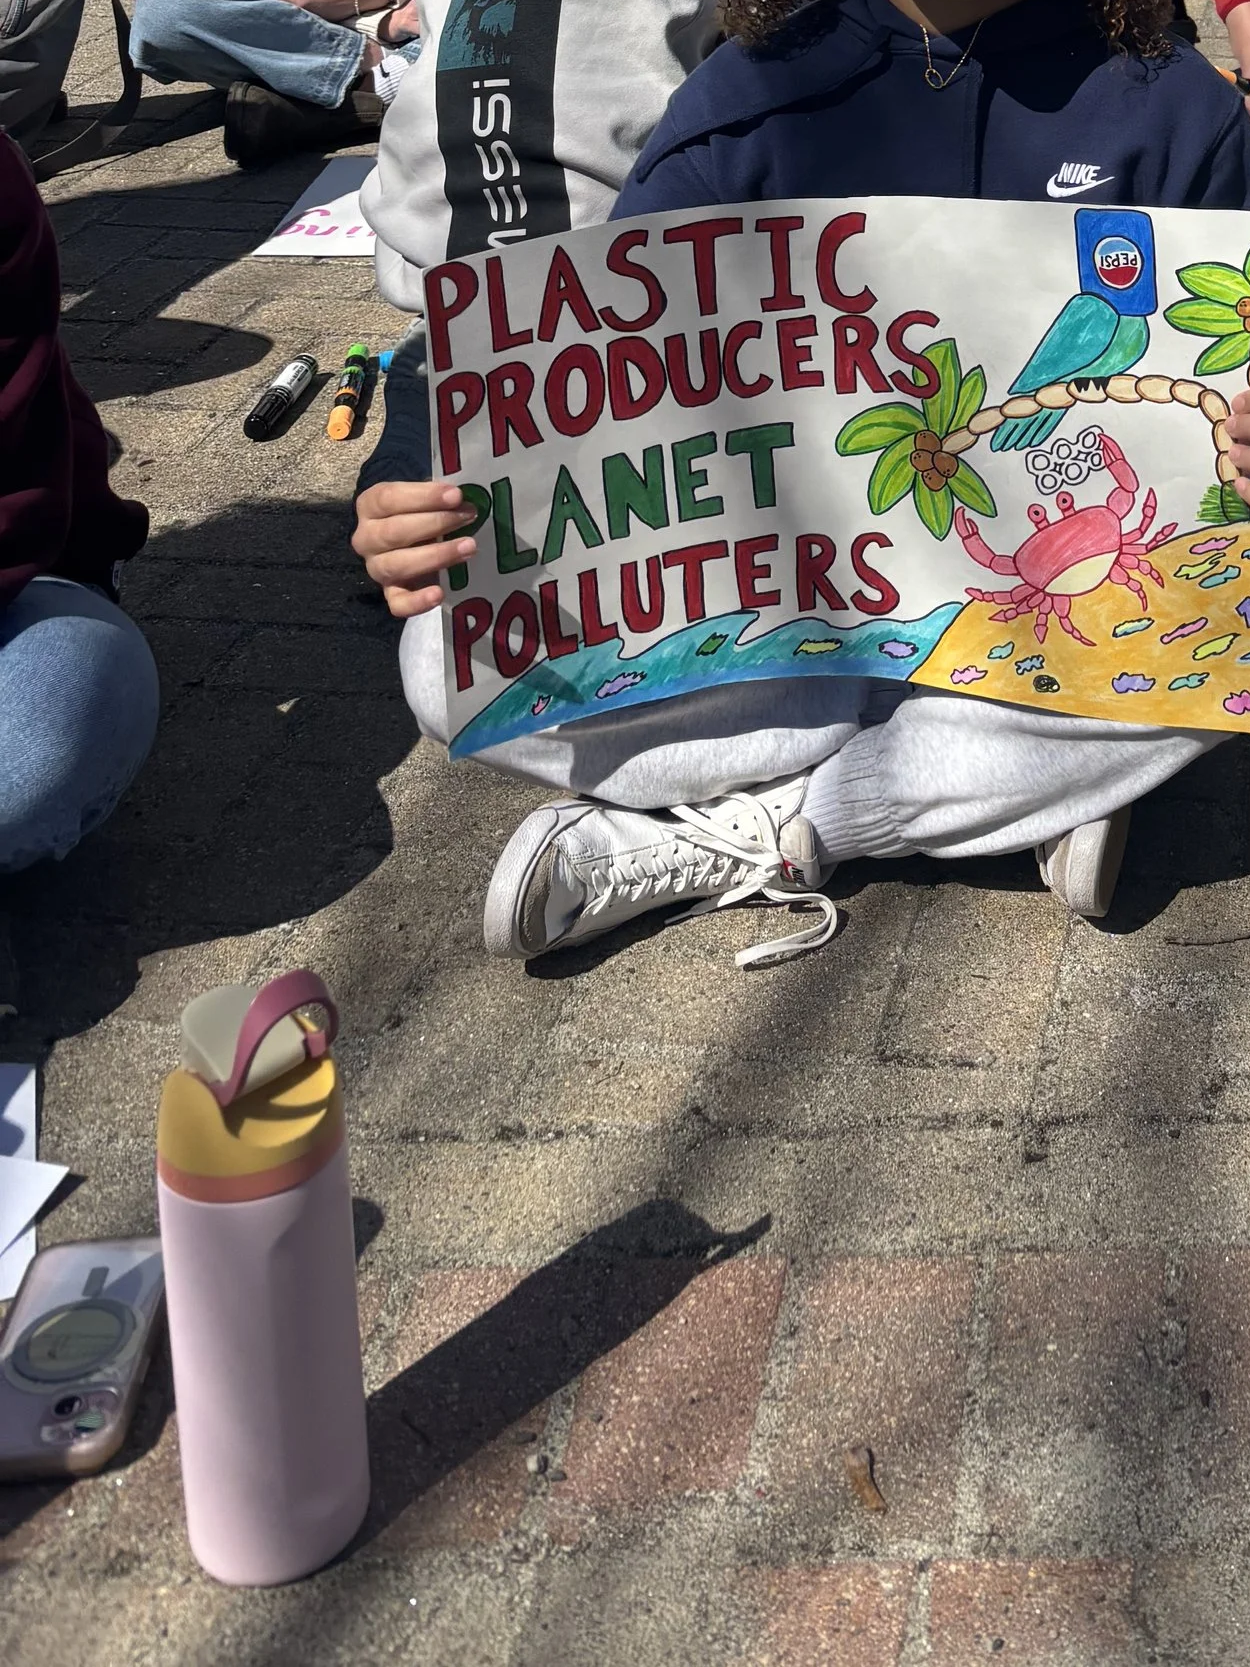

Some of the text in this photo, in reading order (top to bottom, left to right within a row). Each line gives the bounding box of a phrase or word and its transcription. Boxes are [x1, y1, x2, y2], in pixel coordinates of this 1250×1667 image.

[1057, 162, 1102, 184] NIKE
[423, 211, 878, 373] PLASTIC
[1099, 252, 1139, 269] PEPSI
[434, 310, 943, 477] PRODUCERS
[450, 530, 902, 694] POLLUTERS
